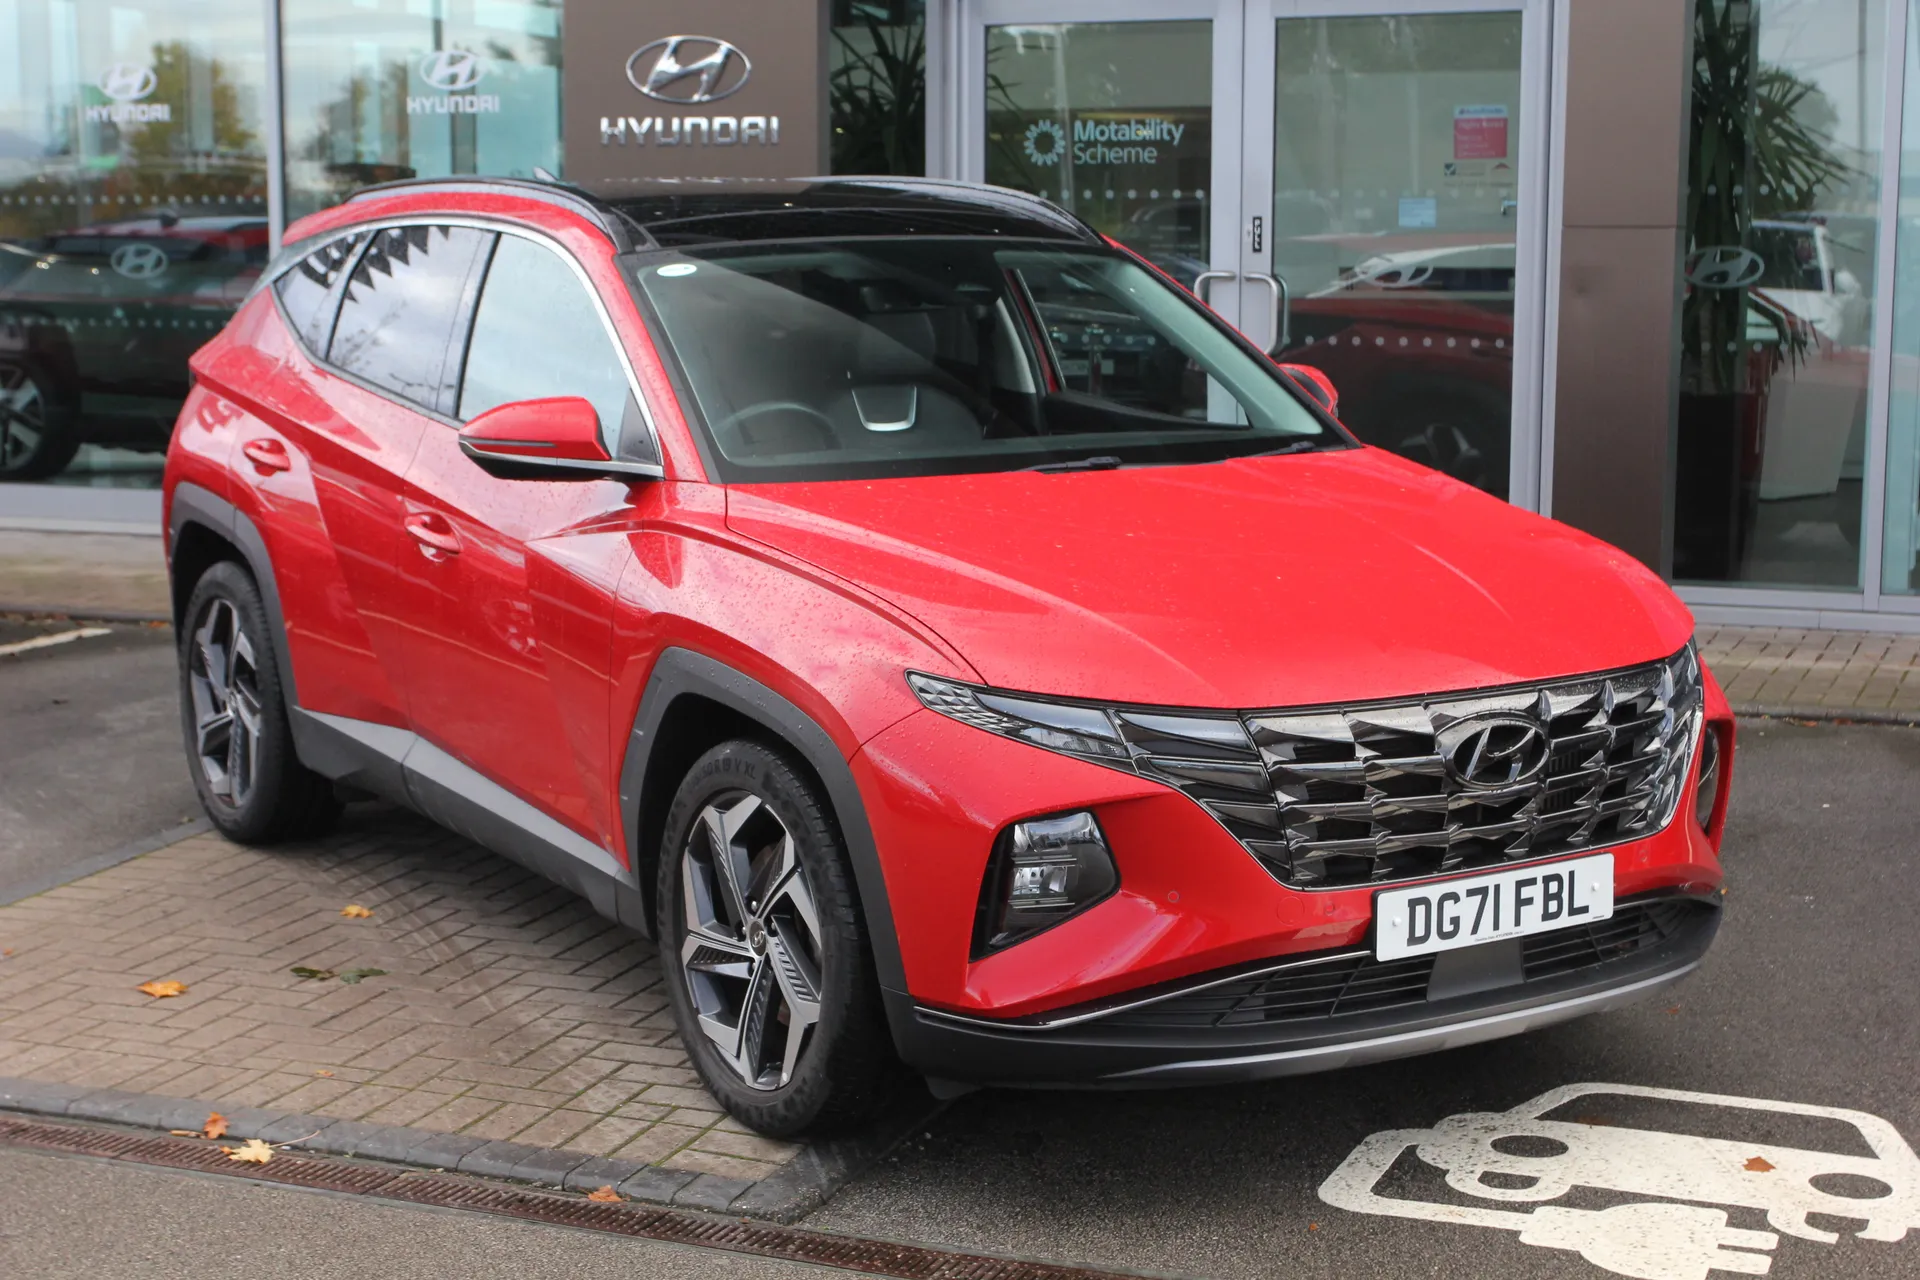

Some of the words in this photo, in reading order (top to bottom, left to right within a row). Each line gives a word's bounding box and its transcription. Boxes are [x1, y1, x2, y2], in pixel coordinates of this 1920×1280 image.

[86, 104, 171, 122] HYUNDAI
[406, 95, 499, 114] HYUNDAI
[600, 116, 779, 145] HYUNDAI
[1074, 118, 1185, 147] Motability
[1074, 143, 1158, 165] Scheme
[1406, 884, 1501, 947] DG71
[1514, 869, 1590, 928] FBL
